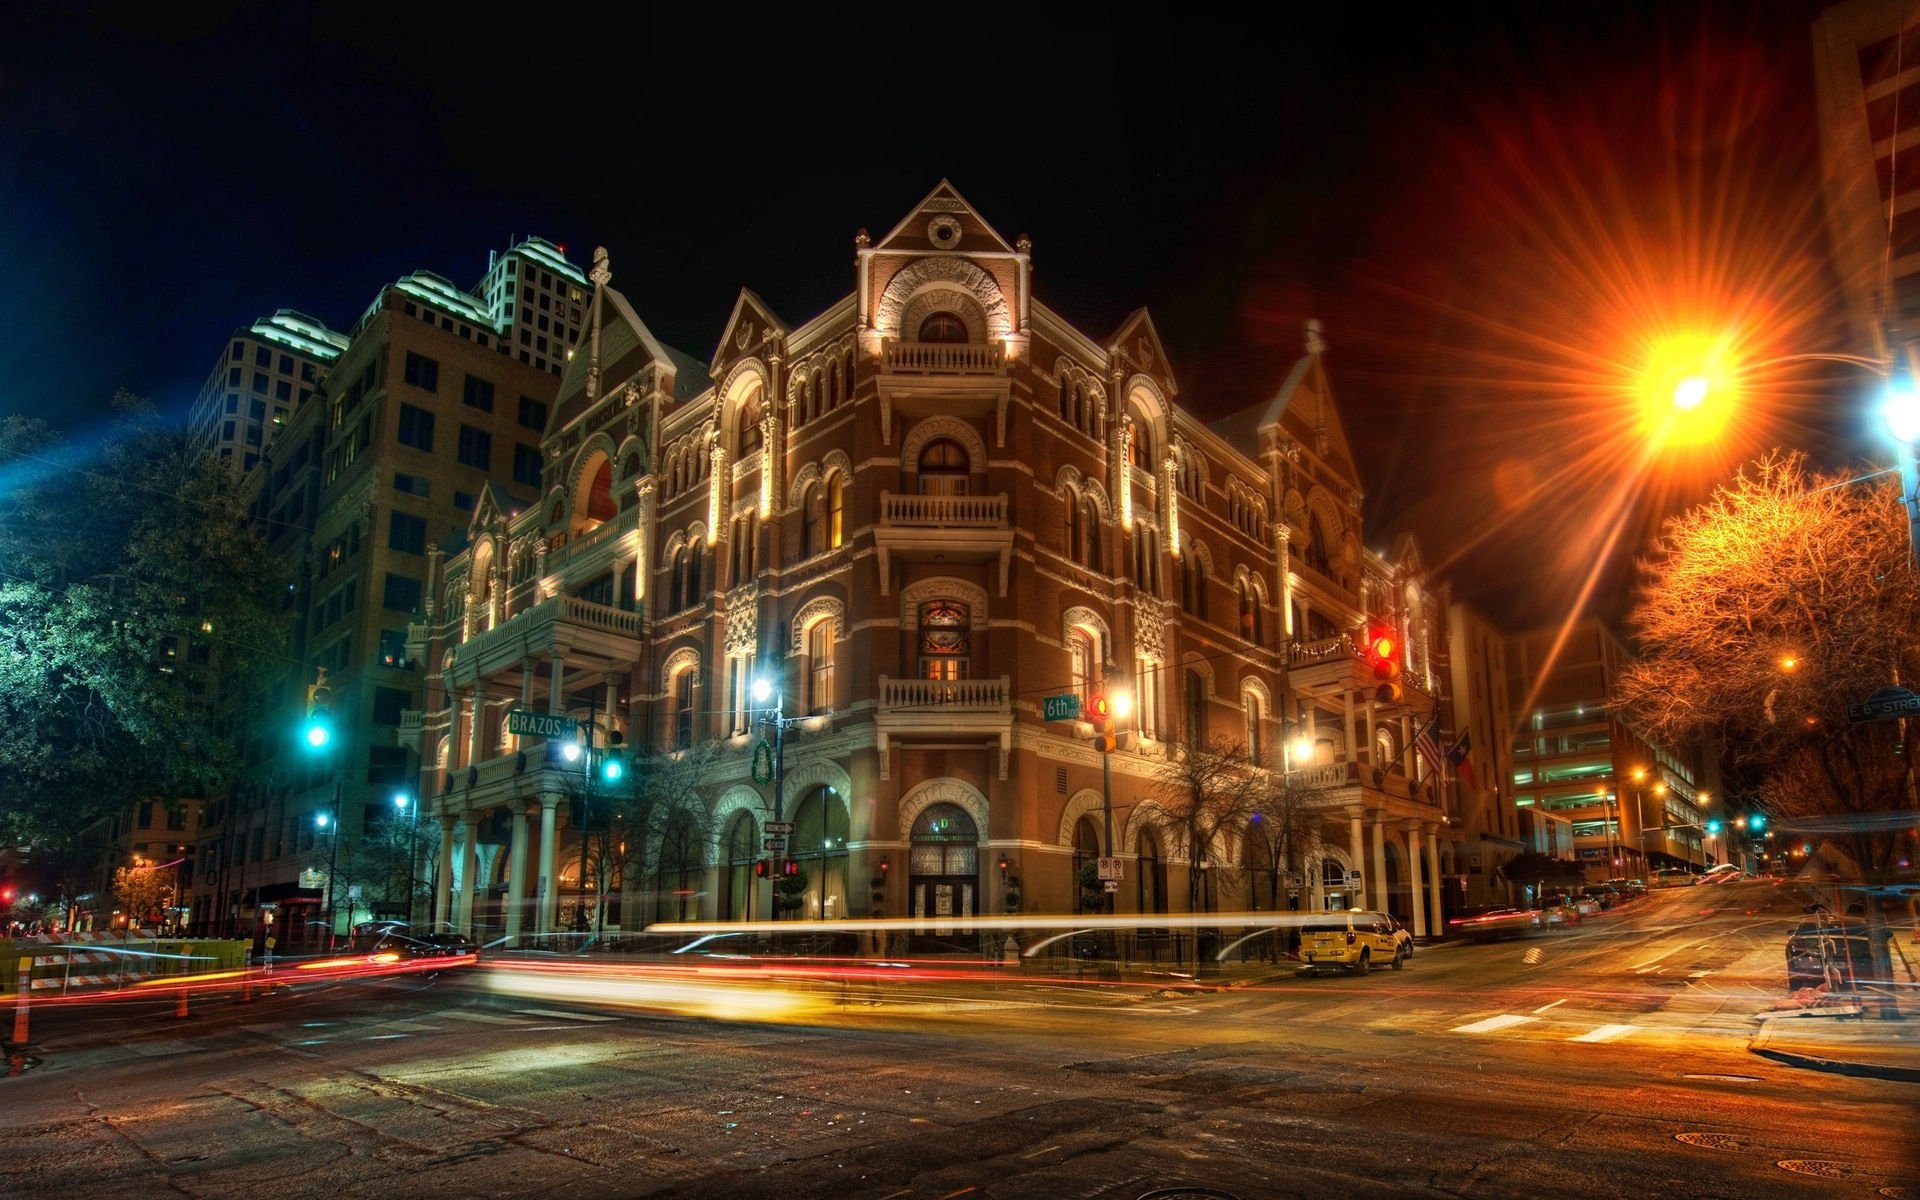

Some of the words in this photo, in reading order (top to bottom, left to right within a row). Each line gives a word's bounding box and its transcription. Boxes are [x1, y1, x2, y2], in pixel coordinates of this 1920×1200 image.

[1048, 699, 1067, 717] 6th
[511, 714, 561, 736] BRAZOS
[566, 718, 575, 728] ST
[561, 730, 576, 740] 600
